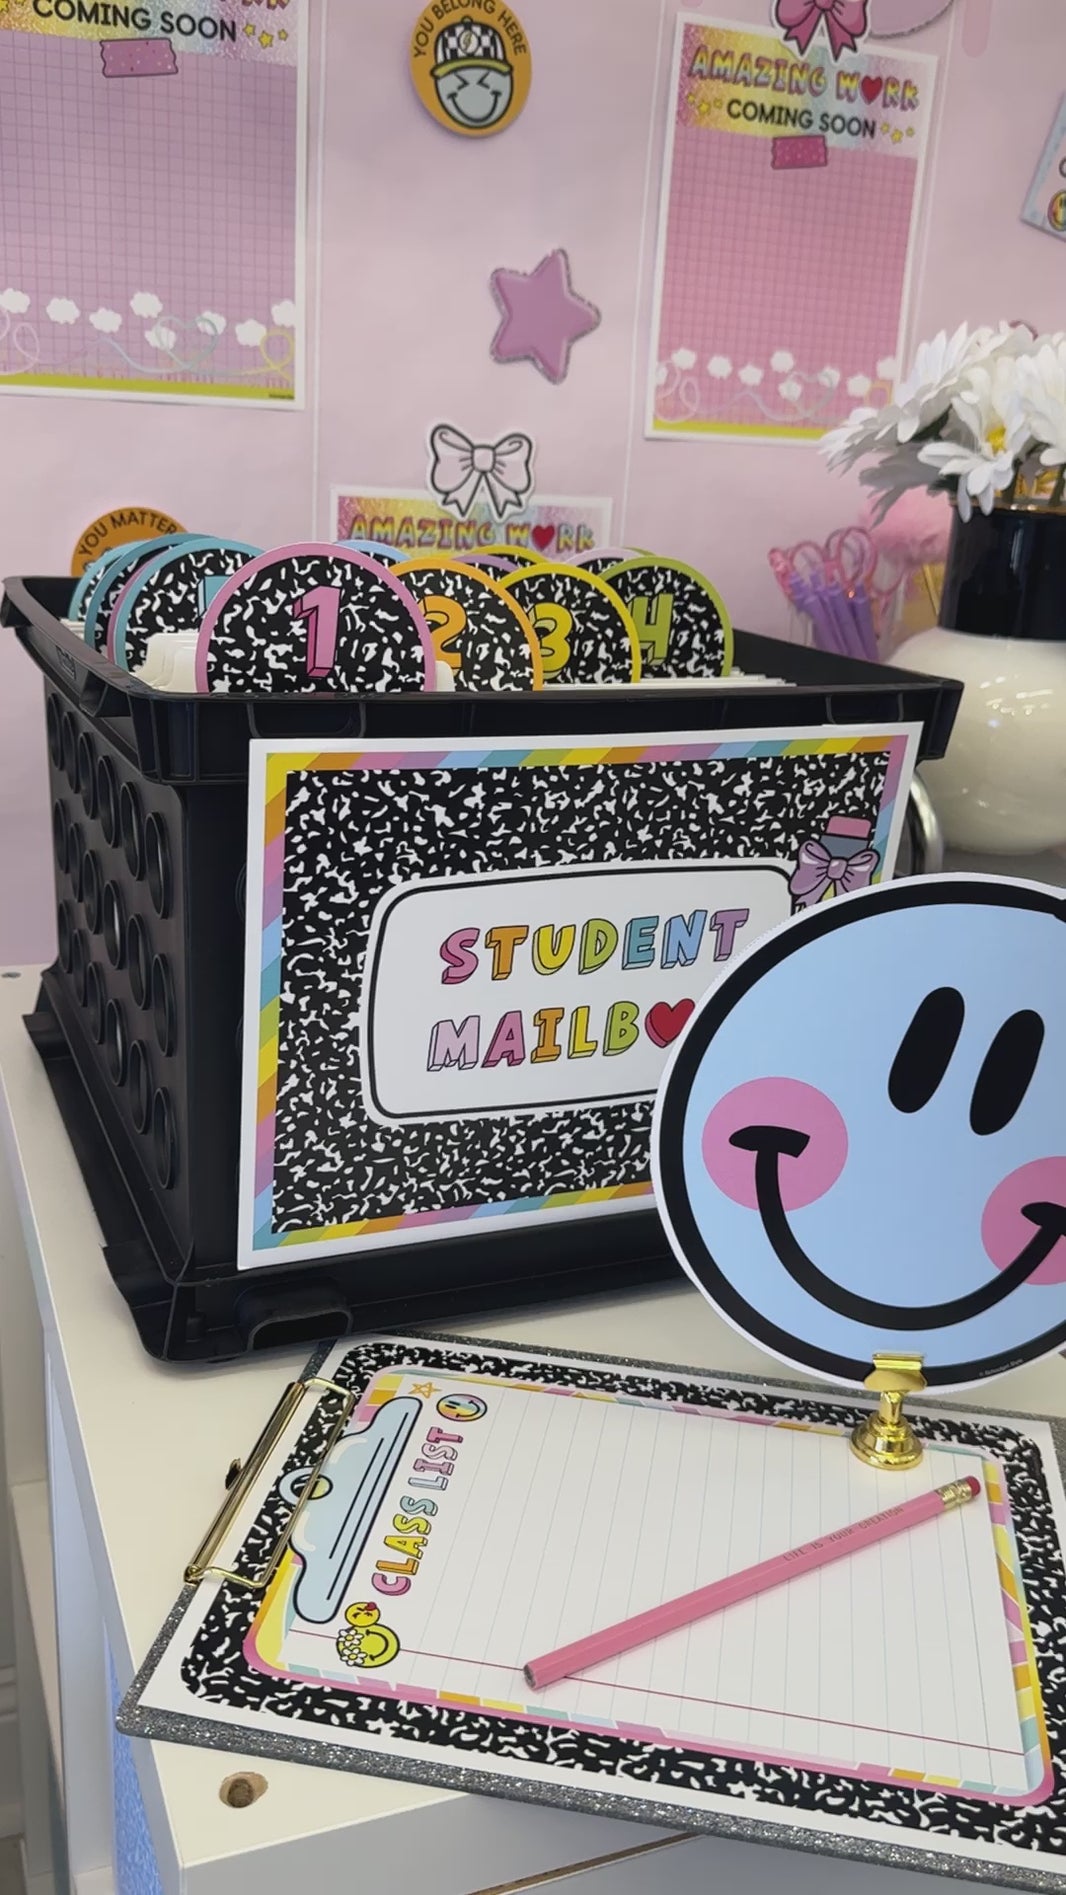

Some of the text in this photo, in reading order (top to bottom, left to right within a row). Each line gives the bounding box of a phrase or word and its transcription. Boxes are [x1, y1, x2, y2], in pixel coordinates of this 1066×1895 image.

[32, 0, 237, 42] COMING SOON
[413, 0, 527, 58] YOU BELONG HERE
[688, 45, 827, 96] AMAZING
[727, 99, 877, 139] COMING SOON
[78, 511, 178, 557] YOU MATTER
[349, 513, 496, 551] AMAZING
[292, 585, 342, 680] 1
[419, 594, 467, 677] 2
[527, 601, 574, 681] 3
[627, 592, 675, 667] 4
[439, 908, 751, 986] STUDENT
[371, 1427, 463, 1597] CLASS LIST
[783, 1548, 807, 1561] LIFE
[811, 1541, 823, 1550] IS
